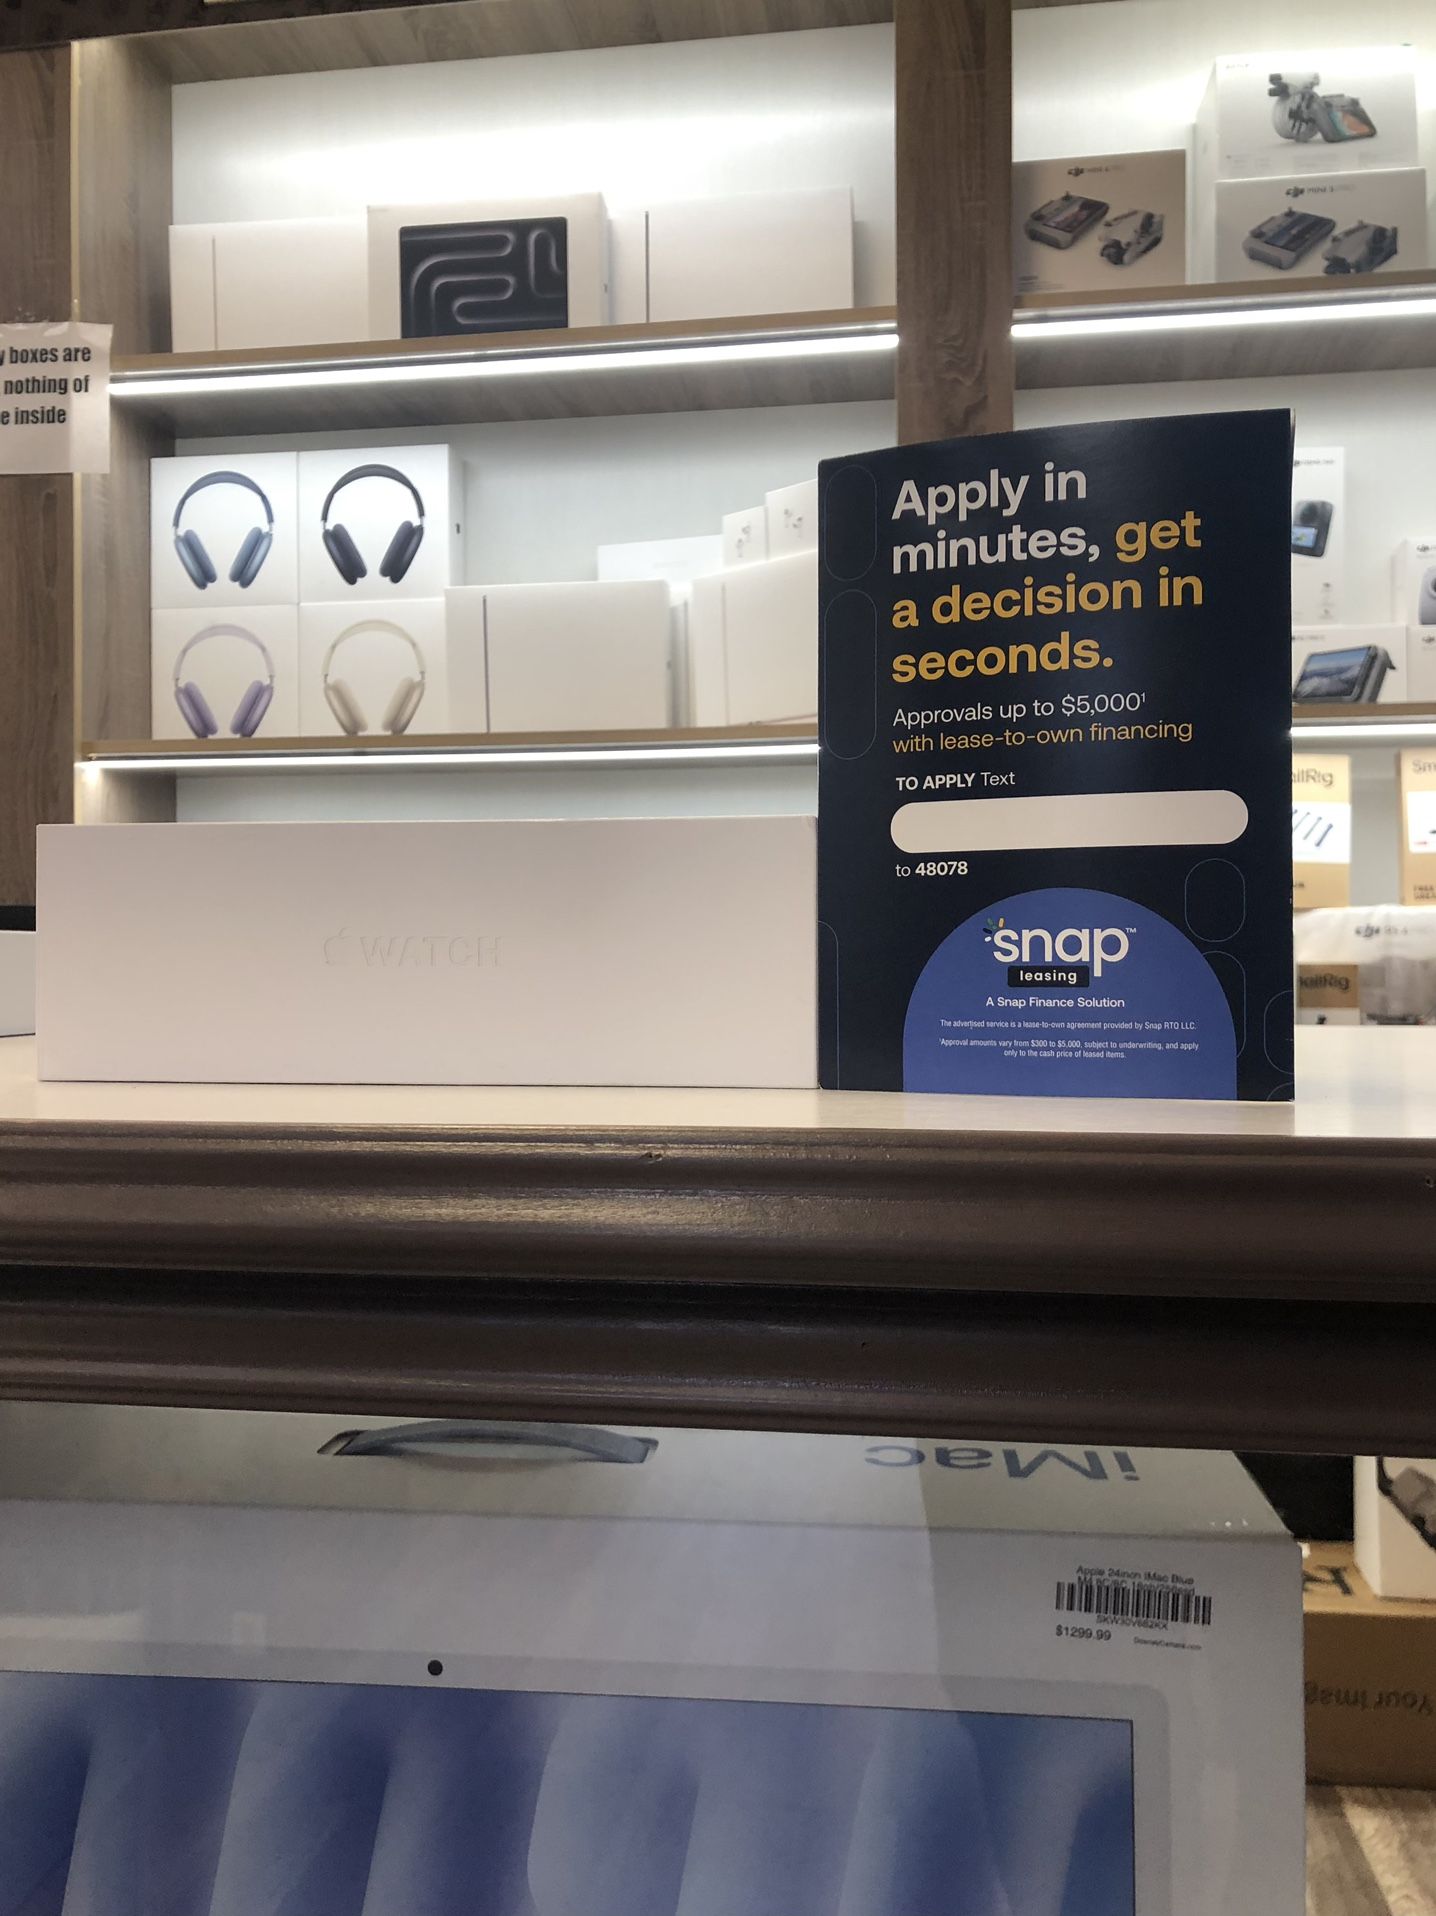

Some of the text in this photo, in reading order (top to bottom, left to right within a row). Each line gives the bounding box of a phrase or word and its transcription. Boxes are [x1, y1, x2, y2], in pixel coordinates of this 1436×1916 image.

[9, 347, 59, 363] boxes
[63, 347, 91, 361] are
[4, 375, 90, 394] nothing of
[14, 406, 66, 424] inside
[892, 462, 1086, 525] Apply in
[893, 511, 1201, 574] minutes, get
[892, 566, 1202, 628] a decision in
[892, 631, 1113, 682] seconds.
[893, 703, 992, 729] Approvals
[1000, 704, 1026, 722] up
[1033, 700, 1054, 716] to
[893, 720, 1192, 752] with lease-to-own financing
[896, 772, 1015, 790] TO APPLY Text
[896, 861, 968, 876] to 48078
[361, 935, 503, 968] WATCH
[1020, 970, 1076, 984] leasing
[986, 997, 1124, 1008] A Snap Finance Solution
[986, 1020, 1008, 1028] service
[1010, 1020, 1016, 1028] is
[1023, 1020, 1064, 1028] lease-to-own
[1067, 1021, 1101, 1030] agreement
[1103, 1021, 1132, 1030] provided
[1135, 1021, 1143, 1030] by
[1145, 1021, 1162, 1031] Snap
[1164, 1021, 1179, 1029] RTO
[1004, 1049, 1018, 1059] only
[1057, 1050, 1073, 1059] price
[1075, 1050, 1081, 1058] of
[1083, 1050, 1104, 1058] leased
[1014, 1039, 1029, 1047] from
[1085, 1041, 1108, 1050] subject
[1180, 1042, 1198, 1051] apply
[864, 1443, 1140, 1481] iMac
[1076, 1565, 1105, 1576] Apple
[1171, 1574, 1194, 1585] Blue
[1056, 1625, 1111, 1641] $1299.99
